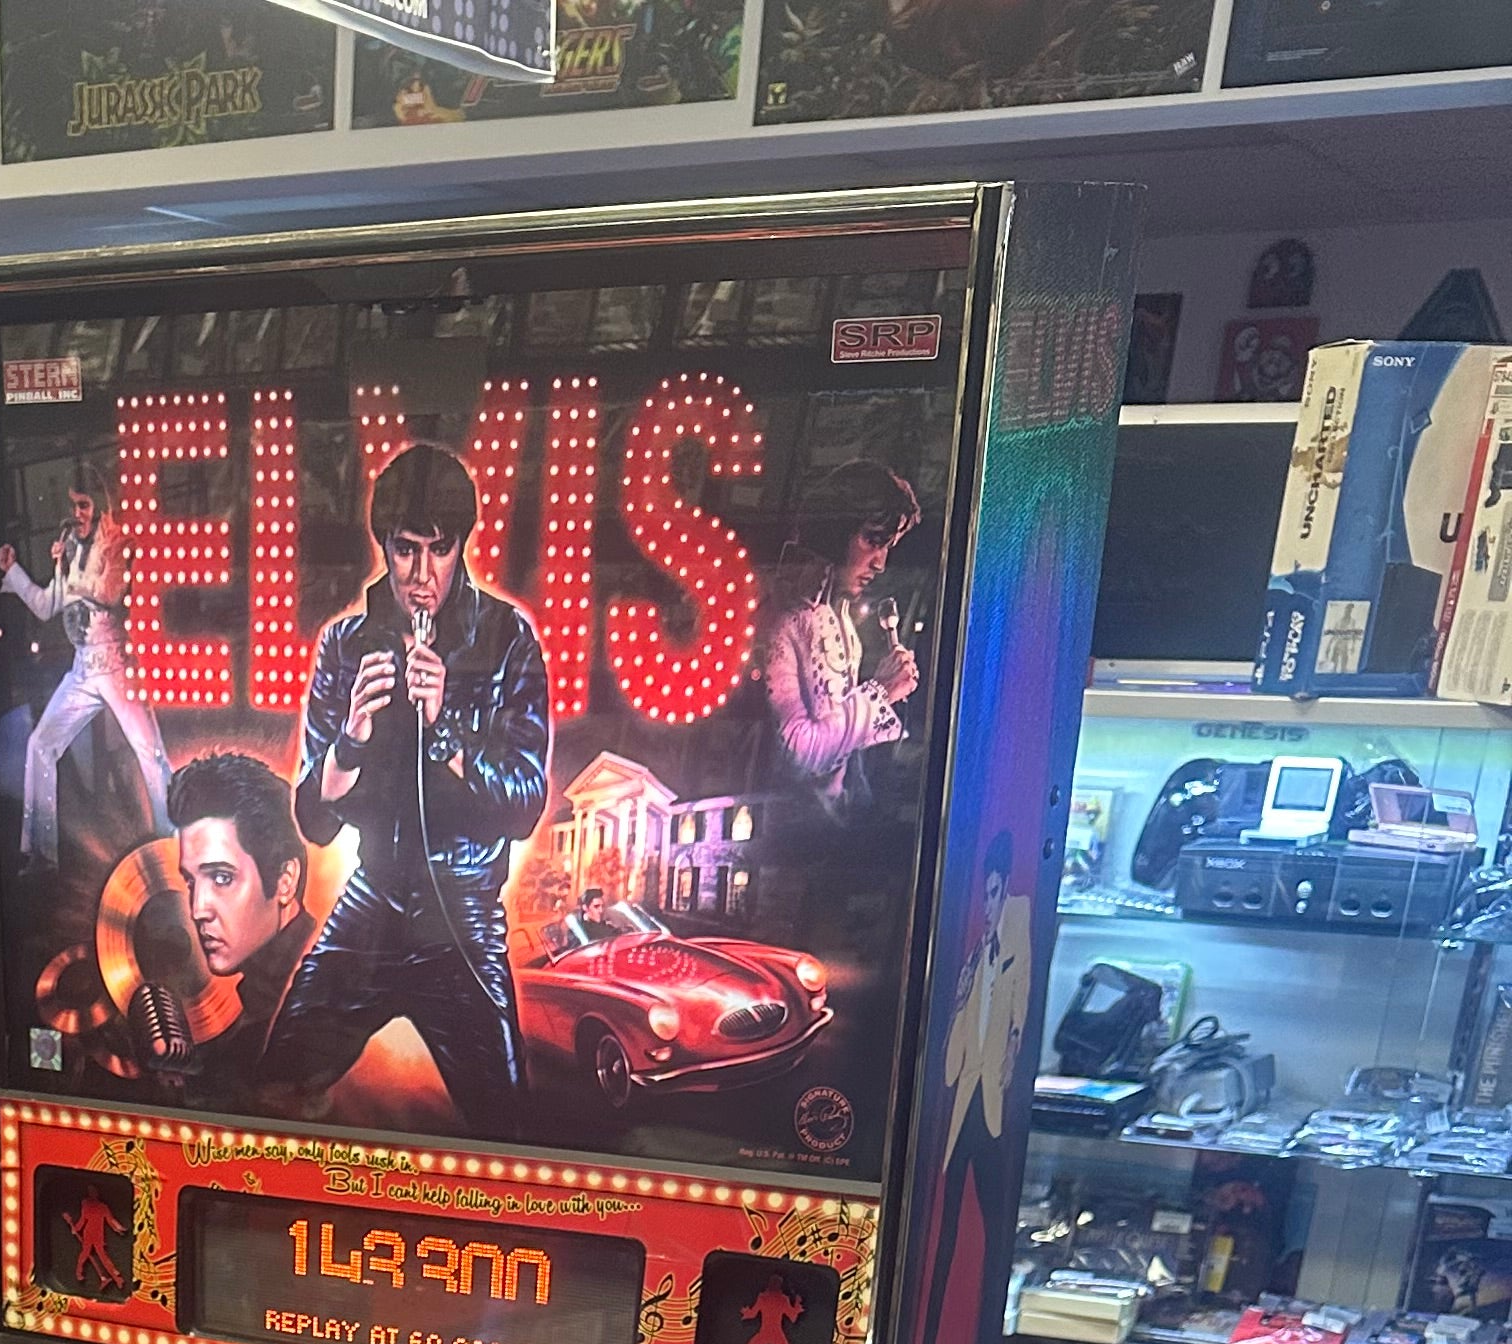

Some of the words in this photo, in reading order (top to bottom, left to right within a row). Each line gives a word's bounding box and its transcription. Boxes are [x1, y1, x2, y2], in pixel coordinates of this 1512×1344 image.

[67, 76, 188, 137] JURASSIC
[180, 66, 263, 130] PARK
[839, 321, 936, 347] SRP
[6, 362, 80, 389] STERN
[1373, 356, 1415, 368] SONY
[1300, 385, 1336, 540] UNCHARTED
[116, 373, 765, 722] ELVIS
[1195, 722, 1309, 742] GENESIS
[800, 1089, 850, 1113] SIGNATURE
[800, 1128, 847, 1149] PRODUCT
[185, 1136, 231, 1167] Wise
[233, 1141, 263, 1158] men
[264, 1141, 294, 1165] say,
[297, 1143, 328, 1165] only
[329, 1143, 361, 1167] fools
[365, 1148, 399, 1173] rush
[323, 1167, 367, 1196] But
[369, 1168, 386, 1199] I
[421, 1182, 451, 1207] help
[454, 1185, 502, 1216] falling
[505, 1193, 523, 1211] in
[525, 1191, 556, 1214] love
[558, 1193, 592, 1216] with
[264, 1309, 360, 1343] REPLAY
